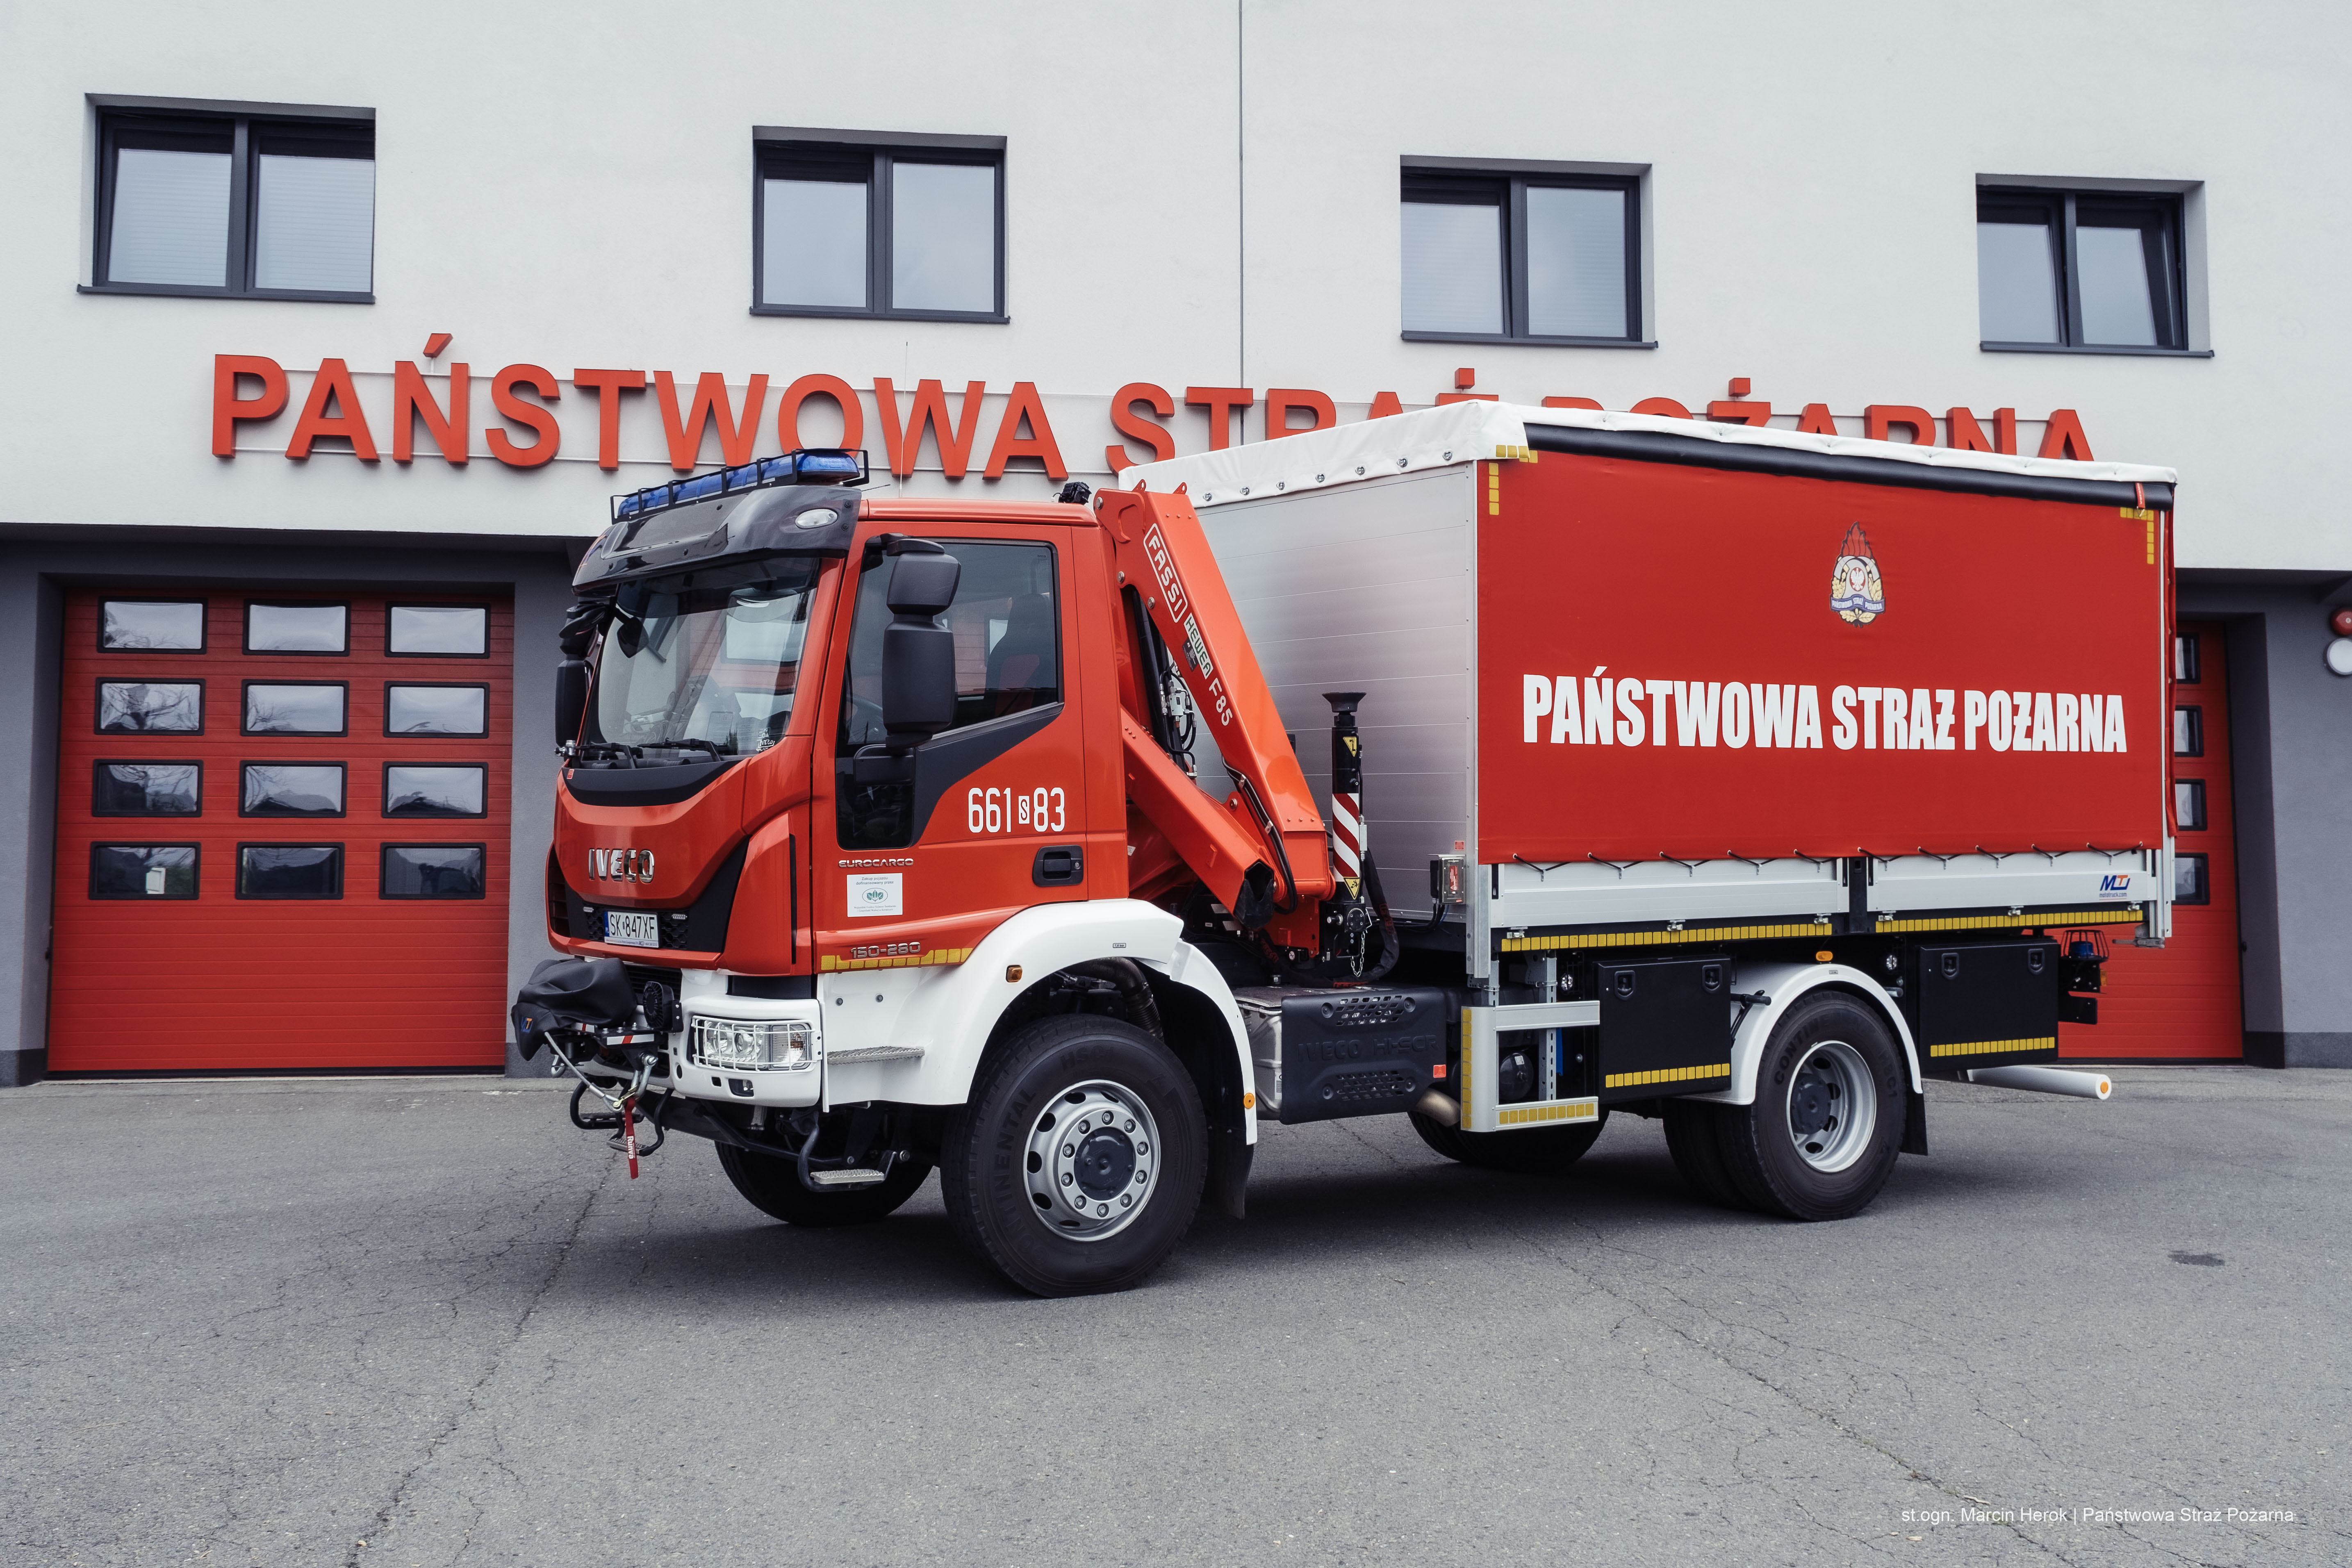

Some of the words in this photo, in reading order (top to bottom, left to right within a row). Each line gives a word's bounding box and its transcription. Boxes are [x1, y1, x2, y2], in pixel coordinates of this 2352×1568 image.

[212, 333, 1068, 481] PAŃSTWOWA
[1148, 535, 1183, 612] FASSI
[1209, 678, 1233, 726] F85
[1523, 665, 1823, 749] PAŃSTWOWA
[968, 787, 1011, 833] 661
[1034, 787, 1065, 832] 83
[588, 848, 655, 884] IVECO
[838, 858, 914, 868] EUROCARGO
[610, 914, 622, 937] SK
[625, 915, 655, 939] 847XF
[850, 942, 921, 959] 150-280
[1297, 1039, 1362, 1062] IVECO
